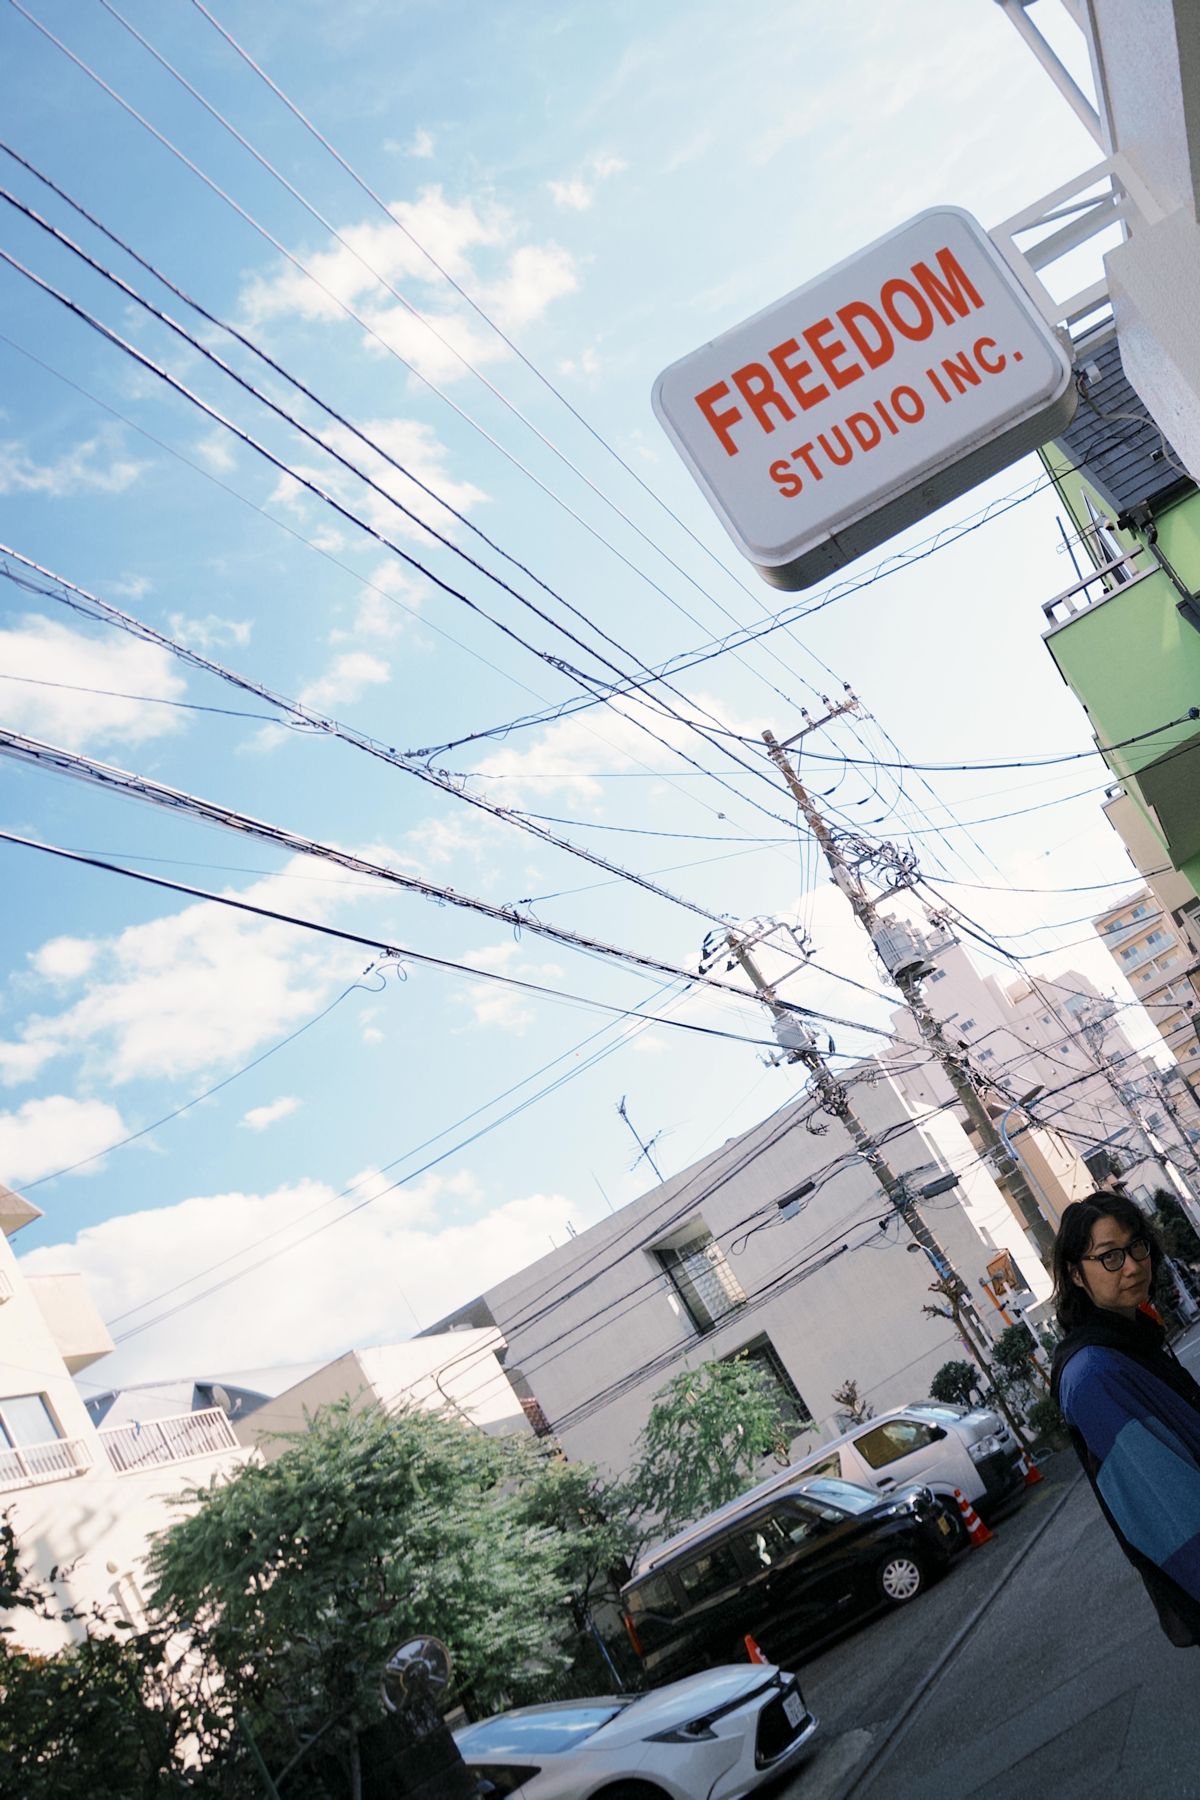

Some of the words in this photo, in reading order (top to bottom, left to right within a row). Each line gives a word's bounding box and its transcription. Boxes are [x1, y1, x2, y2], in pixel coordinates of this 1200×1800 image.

[694, 247, 984, 456] FREEDOM
[769, 385, 925, 497] STUDIO
[926, 336, 1023, 402] INC.
